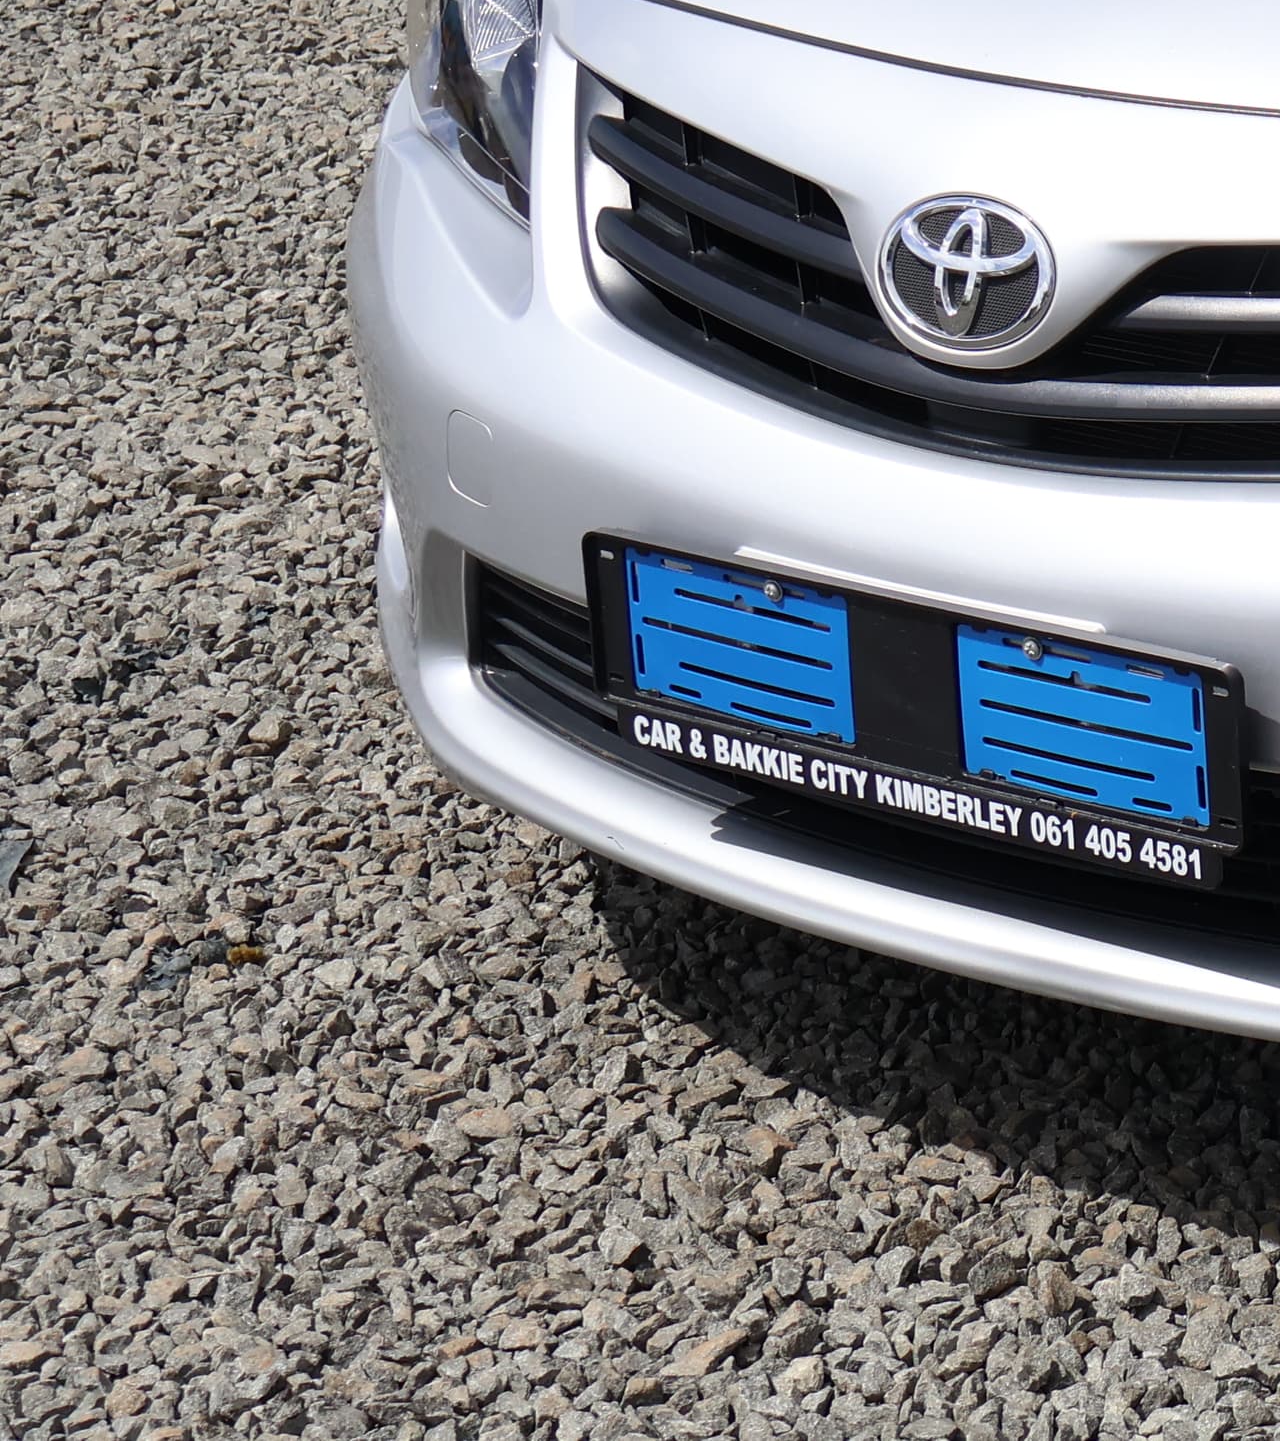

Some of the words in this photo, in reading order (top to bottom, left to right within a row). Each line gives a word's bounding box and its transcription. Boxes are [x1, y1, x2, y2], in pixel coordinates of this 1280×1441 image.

[633, 715, 683, 754] CAR
[689, 728, 707, 759] &
[712, 733, 805, 785] BAKKIE
[810, 758, 868, 799] CITY
[874, 773, 1023, 837] KIMBERLEY
[1030, 811, 1075, 850] 061
[1084, 825, 1132, 863] 405
[1139, 838, 1202, 880] 4581
